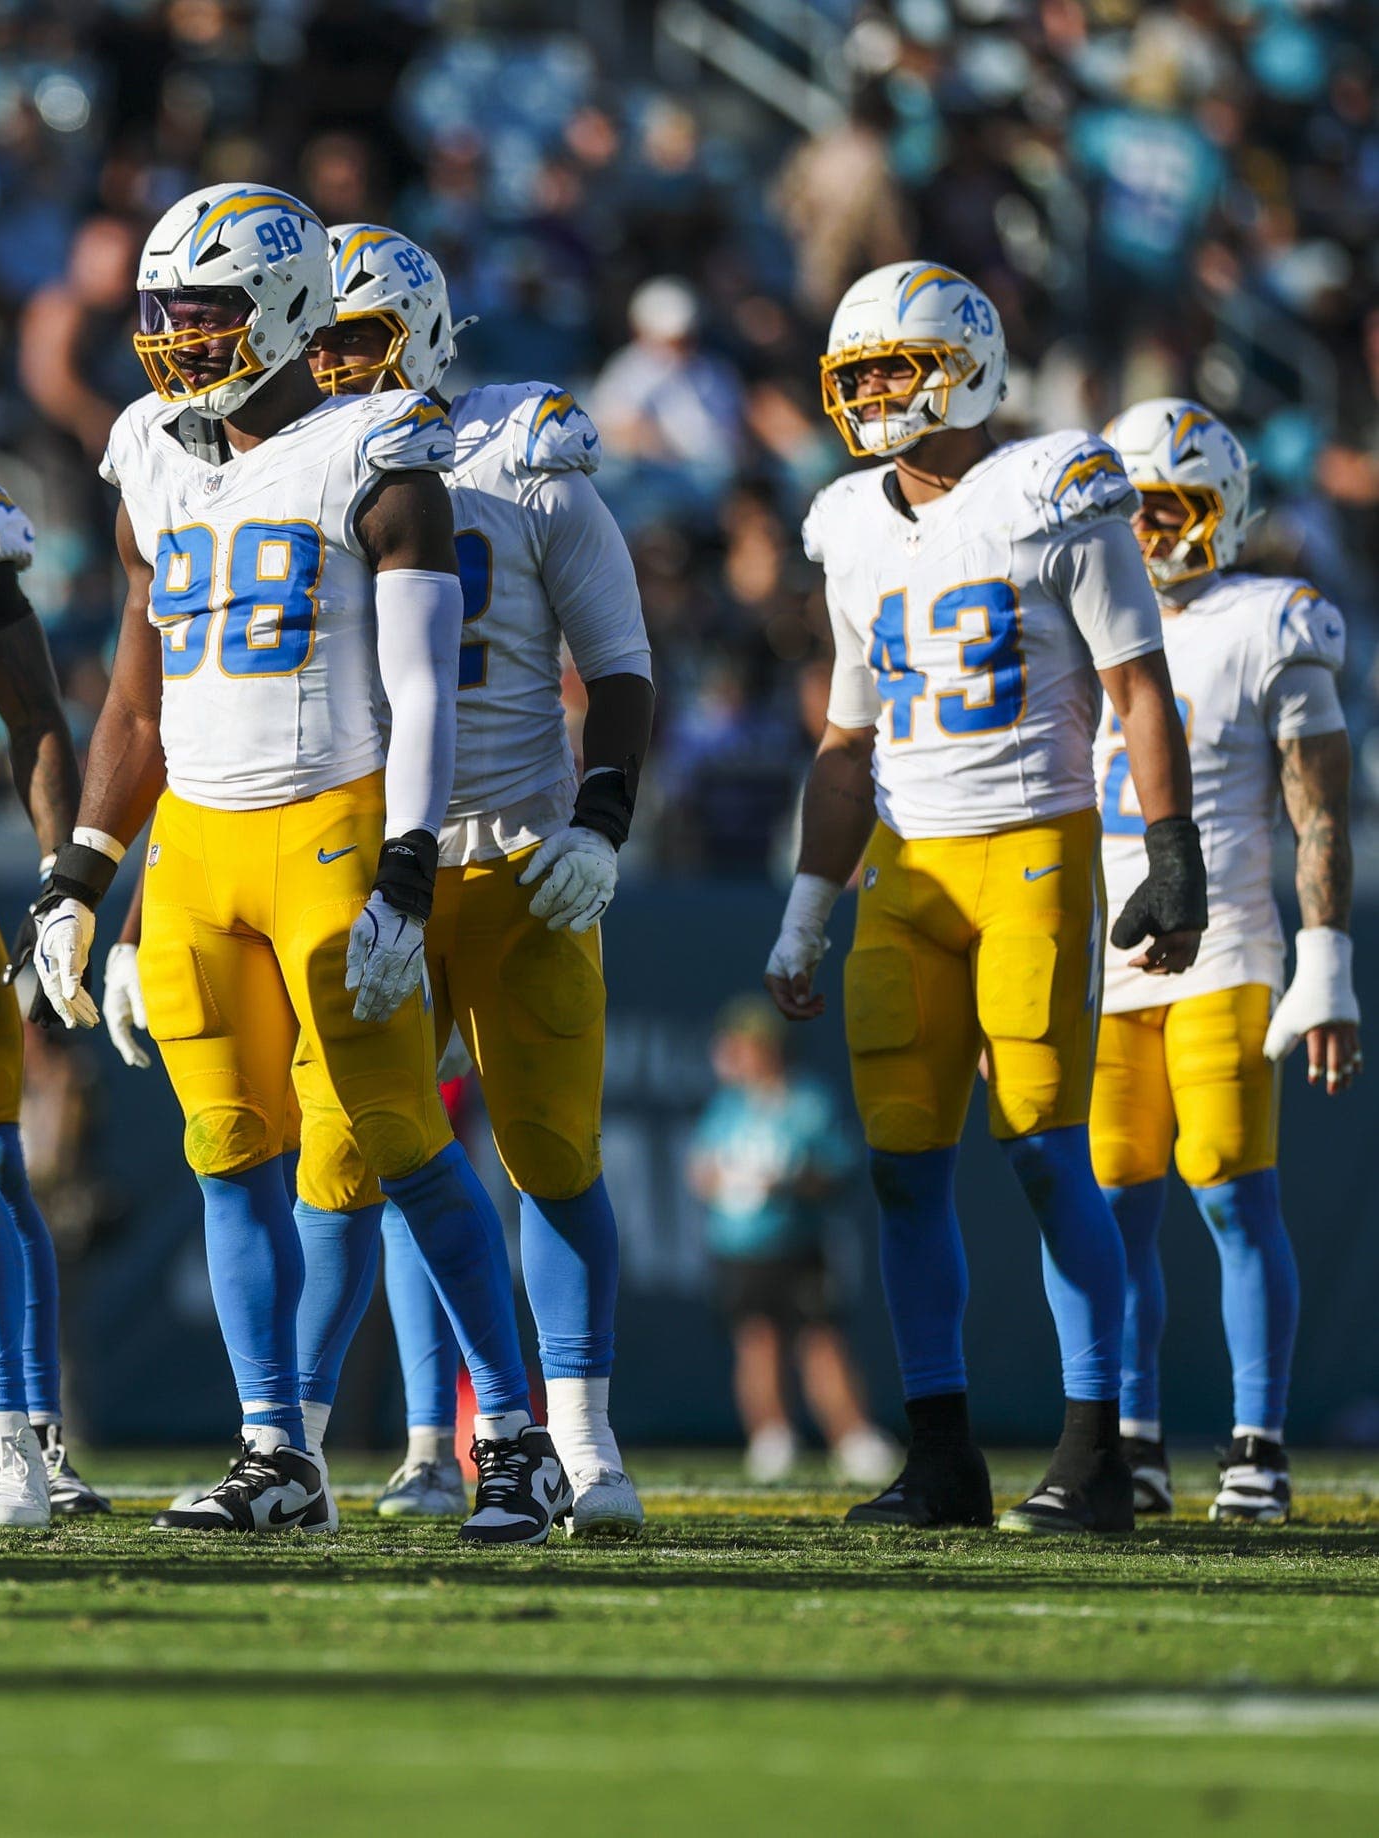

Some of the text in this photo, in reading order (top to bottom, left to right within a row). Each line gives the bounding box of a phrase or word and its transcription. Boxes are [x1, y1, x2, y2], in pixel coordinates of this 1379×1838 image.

[255, 216, 303, 263] 98
[394, 247, 434, 289] 92
[961, 294, 994, 337] 43
[149, 517, 325, 680] 98
[867, 576, 1028, 744] 43
